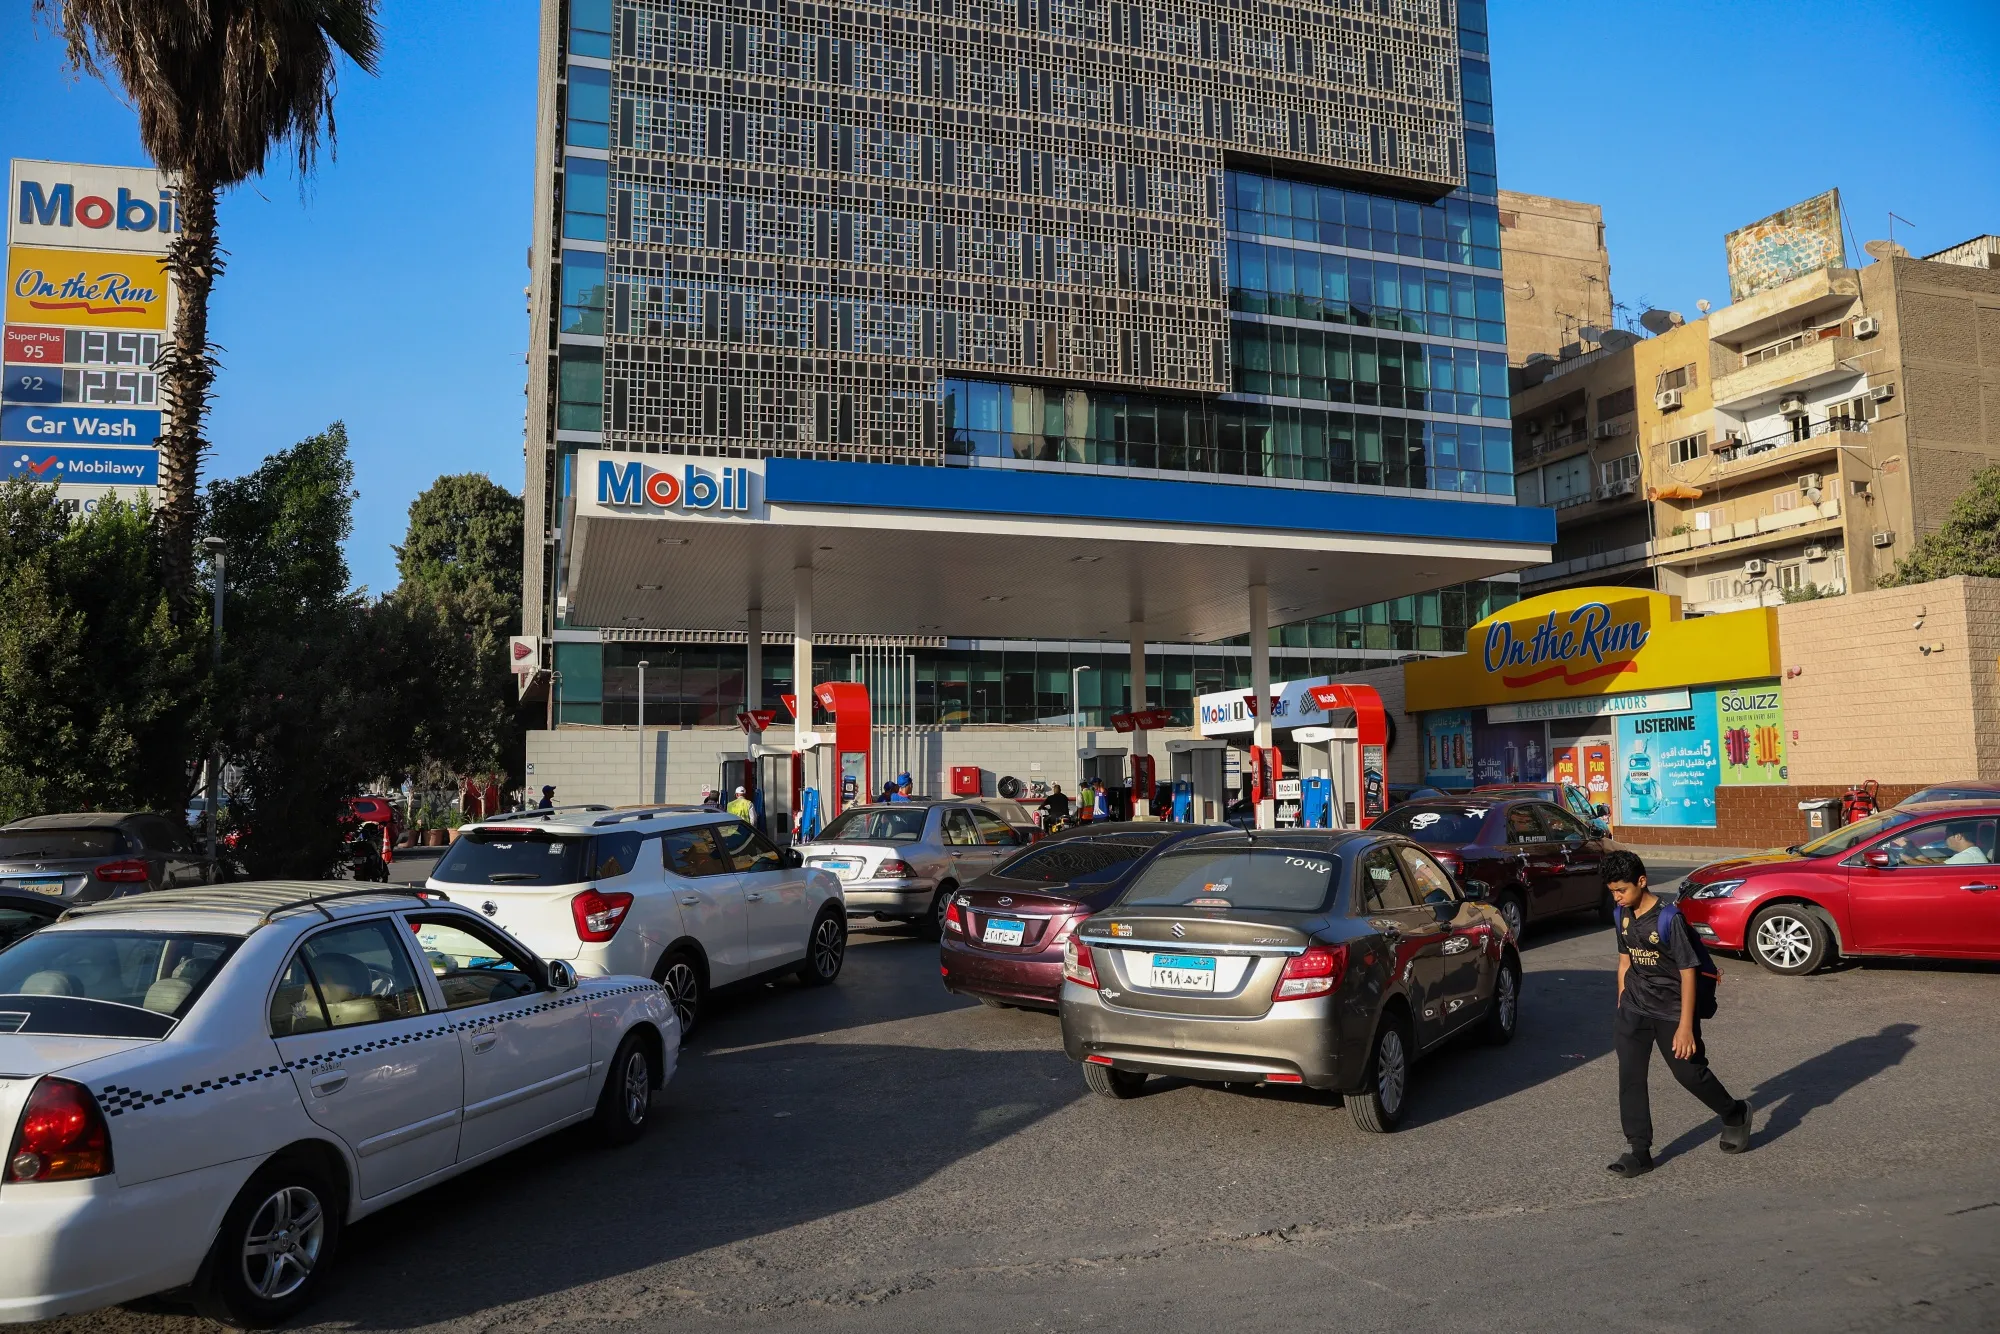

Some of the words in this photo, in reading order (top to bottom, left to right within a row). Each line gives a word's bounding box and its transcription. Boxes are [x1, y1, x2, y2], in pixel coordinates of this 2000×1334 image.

[15, 269, 58, 298] On
[59, 272, 101, 299] the
[97, 273, 159, 305] Run
[8, 331, 37, 342] Super
[39, 333, 61, 342] Plus
[23, 345, 44, 359] 95
[21, 376, 43, 391] 92
[79, 370, 157, 405] 12.50
[26, 415, 67, 434] Car
[72, 417, 136, 437] Wash
[69, 460, 145, 478] Mobilawy
[597, 459, 748, 511] Mobil
[1484, 619, 1531, 673] On
[1530, 609, 1578, 666] the
[1569, 602, 1650, 664] Run
[790, 700, 795, 708] 1
[813, 701, 819, 709] 2
[1252, 700, 1256, 708] 5
[1317, 693, 1337, 703] Mobil
[1721, 693, 1779, 712] SQUIZZ
[1202, 702, 1231, 723] Mobil
[1517, 706, 1523, 719] A
[1525, 703, 1553, 718] FRESH
[1556, 701, 1583, 716] WAVE
[1586, 700, 1598, 713] OF
[1602, 696, 1647, 712] FLAVORS
[1635, 715, 1696, 734] LISTERINE
[1661, 747, 1677, 759] أقوى
[1678, 745, 1703, 756] أضعاف
[1703, 740, 1711, 757] 5
[1558, 762, 1574, 773] PLUS
[1589, 761, 1605, 772] PLUS
[1278, 784, 1293, 792] Mobil
[1588, 781, 1609, 792] OVER
[1284, 856, 1330, 874] TONY
